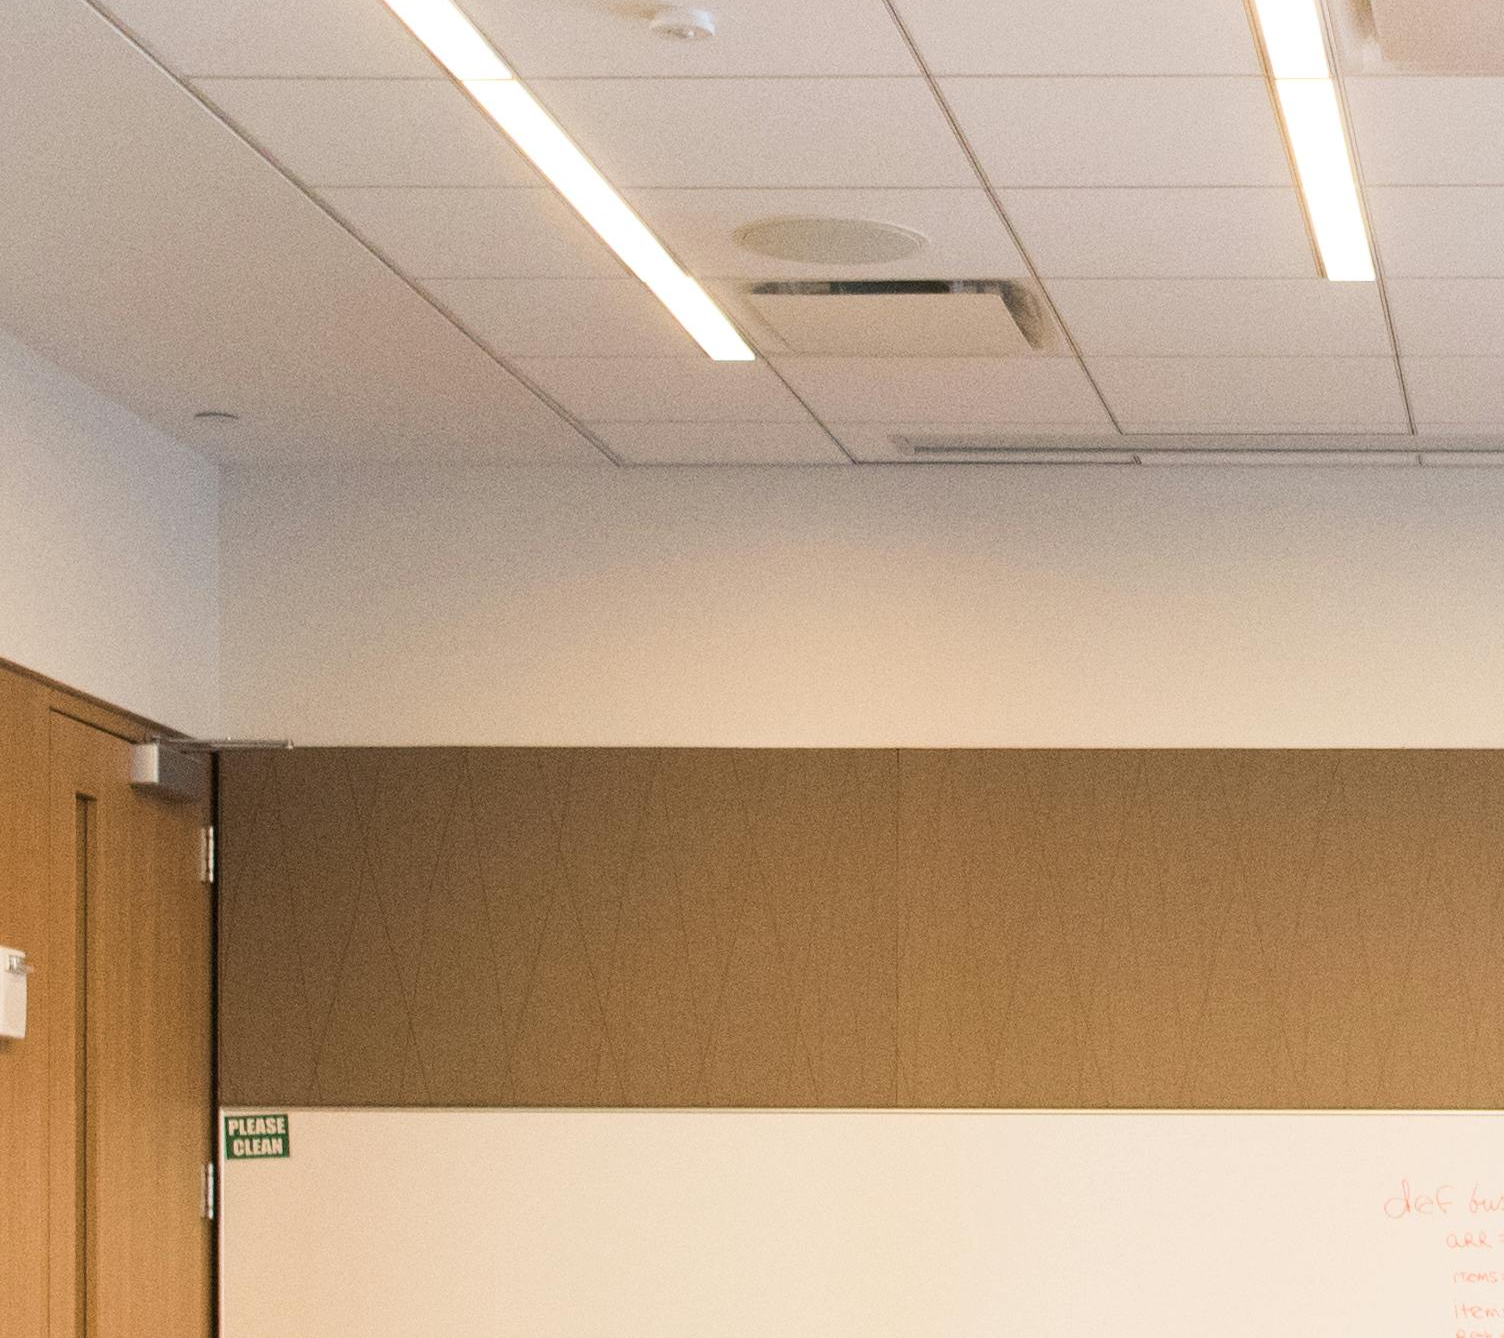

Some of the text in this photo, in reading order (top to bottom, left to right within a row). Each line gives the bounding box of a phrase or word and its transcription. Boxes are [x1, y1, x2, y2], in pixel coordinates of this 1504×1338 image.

[228, 1117, 286, 1136] PLEASE
[232, 1138, 284, 1157] CLEAN
[1383, 1178, 1456, 1219] def
